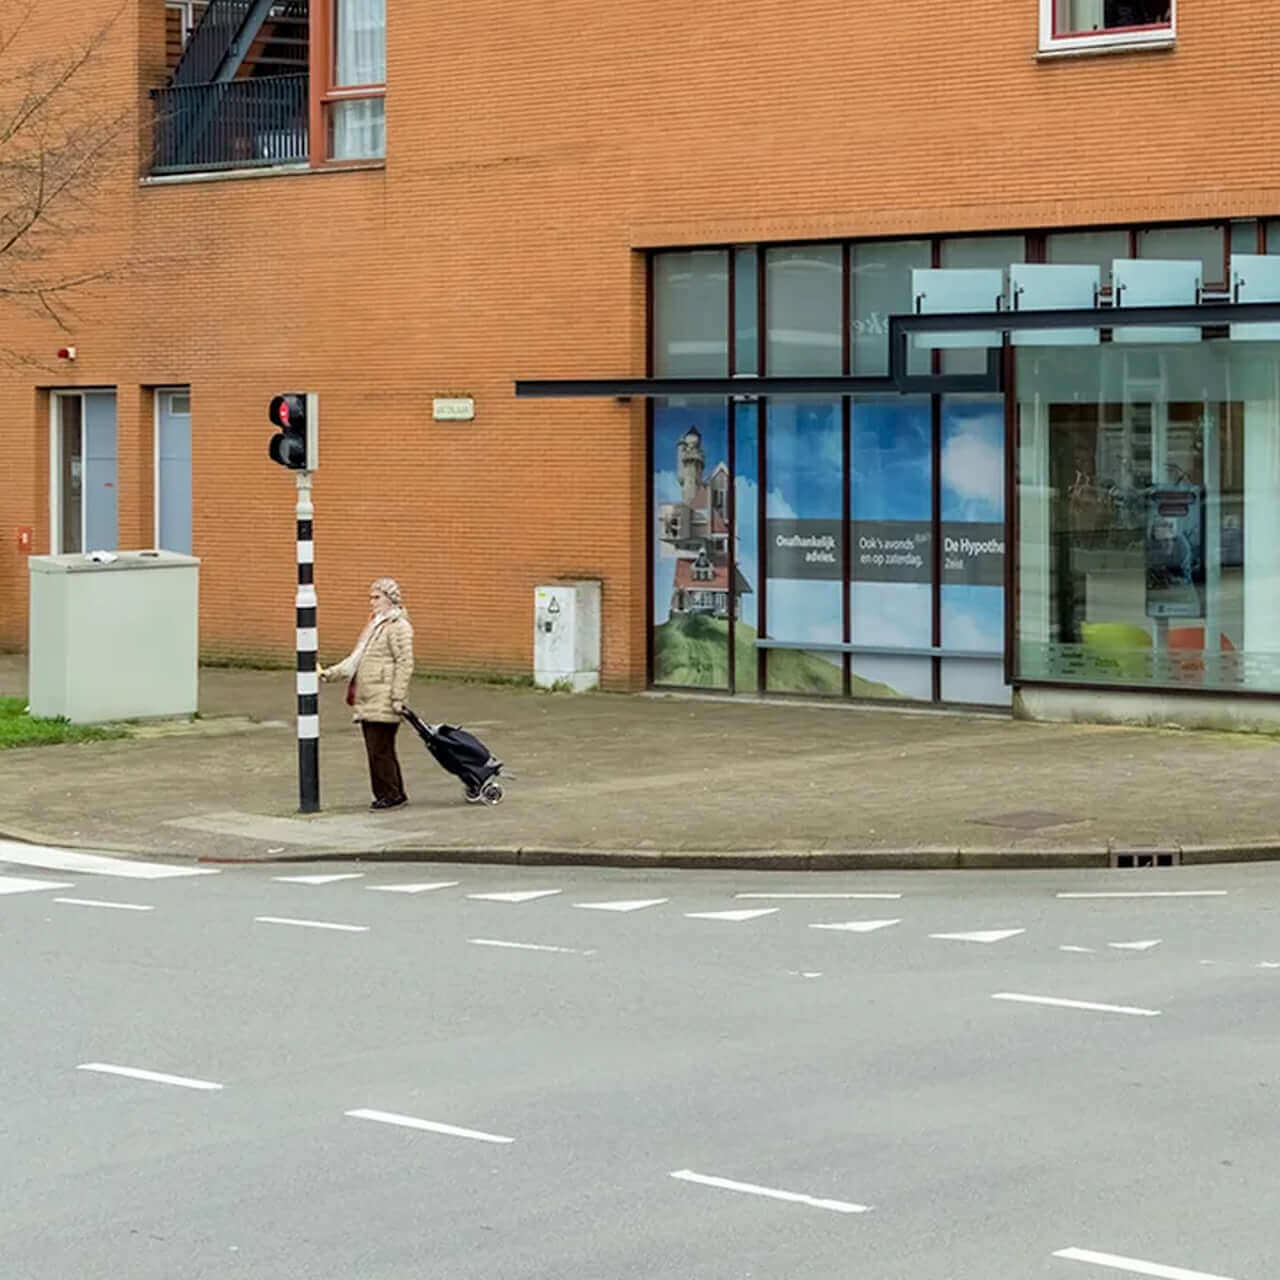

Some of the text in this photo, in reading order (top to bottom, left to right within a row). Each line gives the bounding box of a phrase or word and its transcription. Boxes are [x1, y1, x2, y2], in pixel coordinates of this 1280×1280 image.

[775, 534, 836, 550] Onafhankelijk
[944, 537, 959, 553] De
[805, 550, 837, 564] advies.
